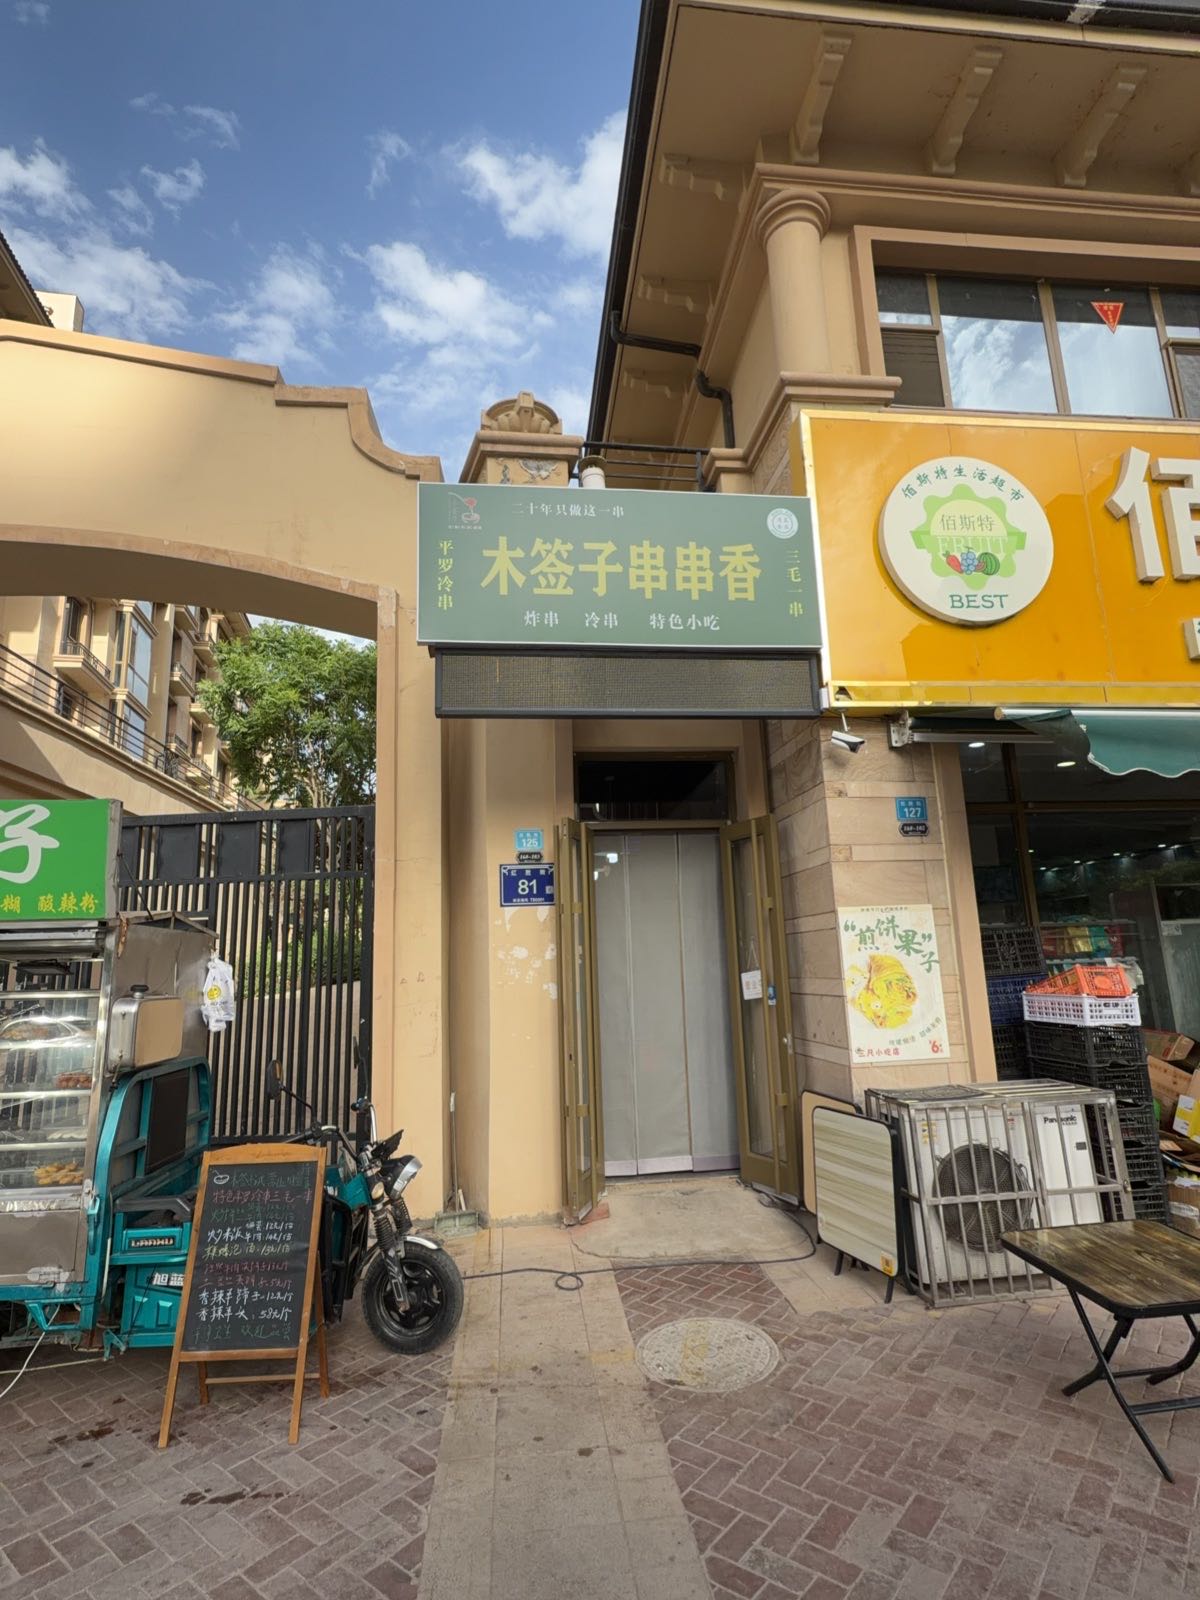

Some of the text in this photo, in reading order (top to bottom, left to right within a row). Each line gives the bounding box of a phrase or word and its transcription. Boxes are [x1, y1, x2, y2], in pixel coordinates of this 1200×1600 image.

[901, 464, 1025, 502] 佰斯特生活超市
[512, 502, 625, 518] 二十年只做这一串
[939, 513, 995, 532] 佰斯特
[436, 539, 454, 611] 平罗冷串
[480, 536, 763, 602] 木签子串串香
[785, 549, 804, 618] 三毛一串
[948, 593, 1009, 609] BEST
[523, 610, 721, 631] 炸串 冷串 特色小吃
[904, 807, 922, 818] 127
[521, 838, 538, 847] 125
[518, 879, 537, 895] 81
[37, 890, 99, 915] 酸辣粉
[1043, 1115, 1077, 1124] Pansonic
